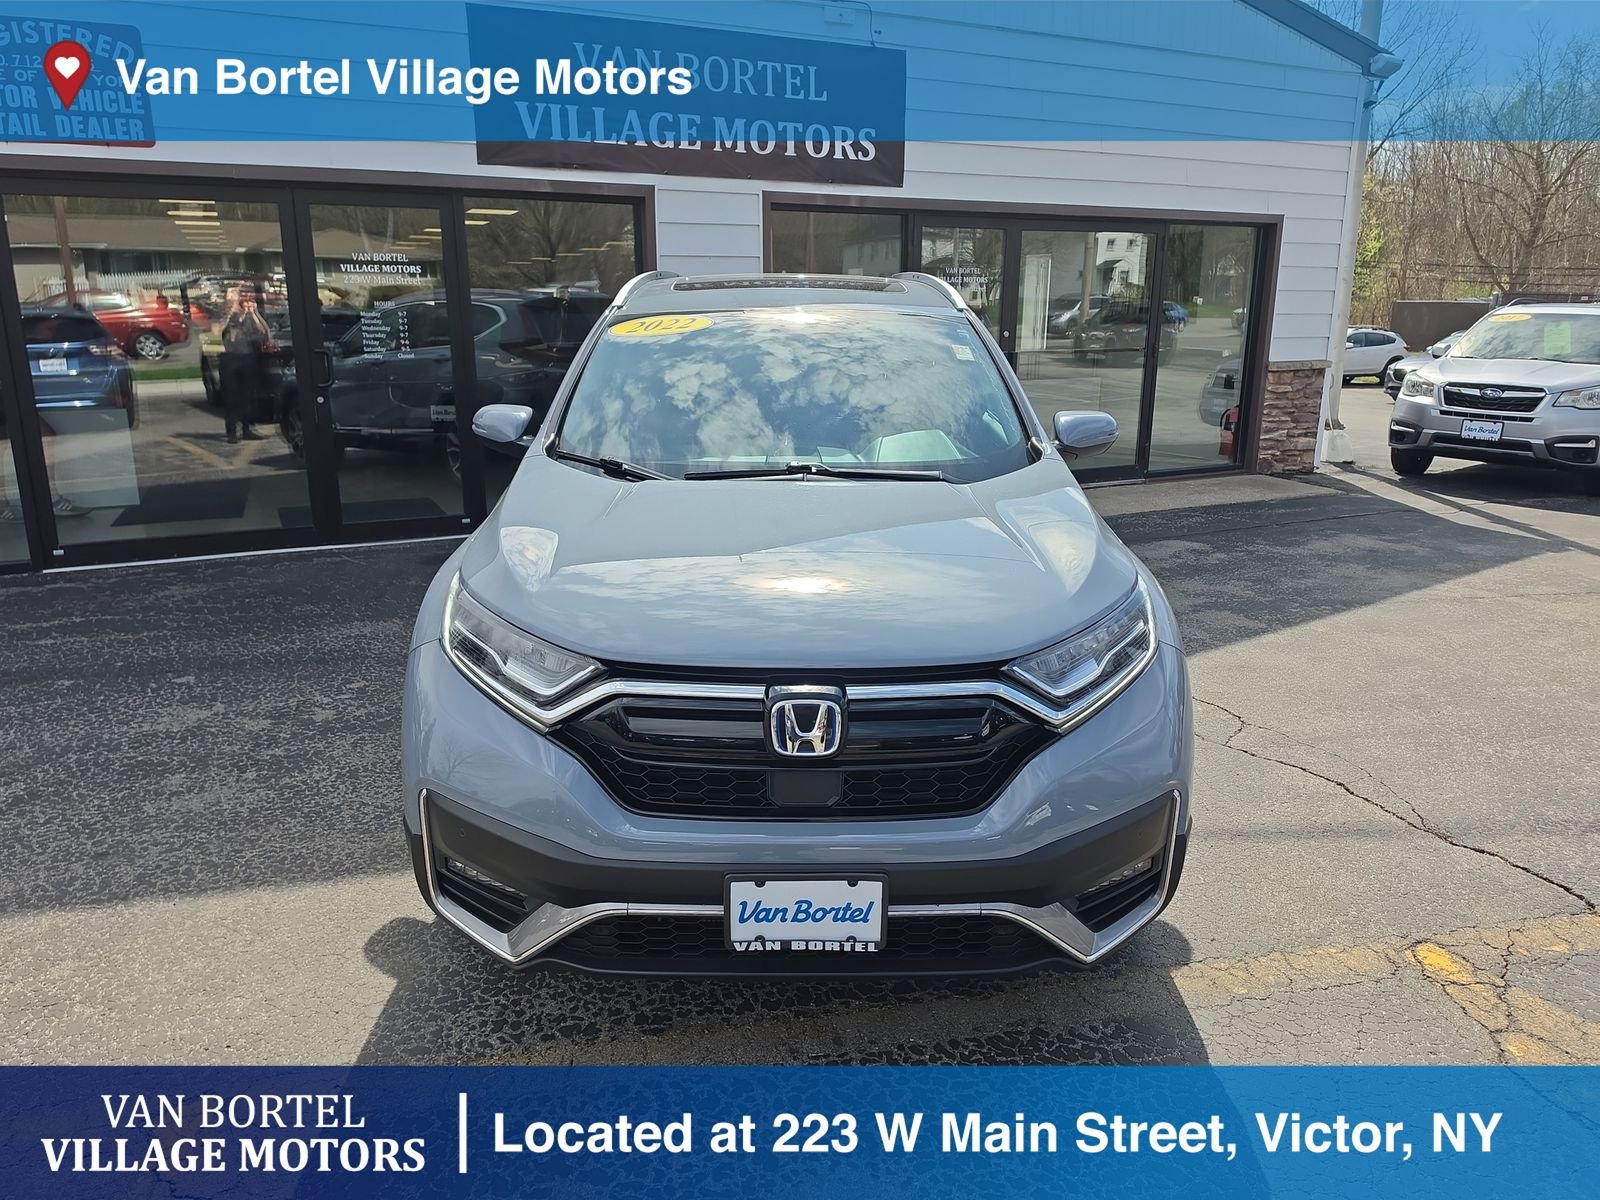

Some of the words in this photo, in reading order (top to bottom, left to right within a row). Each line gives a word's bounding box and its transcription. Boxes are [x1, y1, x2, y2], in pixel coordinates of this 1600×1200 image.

[14, 70, 38, 82] OF
[573, 42, 662, 86] VAN
[676, 52, 827, 101] BORTEL
[48, 87, 145, 115] VHICLE
[55, 115, 144, 140] DEALER
[514, 101, 701, 150] VILLAGE
[713, 116, 876, 161] MOTORS
[352, 252, 370, 261] VAN
[373, 253, 408, 262] BORTEL
[340, 264, 380, 273] VILLAGE
[381, 264, 421, 274] MOTORS
[396, 275, 421, 285] Street
[625, 318, 697, 333] 2022
[738, 900, 788, 924] Van
[790, 899, 875, 924] Bortel
[733, 941, 781, 952] VAN
[791, 941, 879, 952] BORTEL
